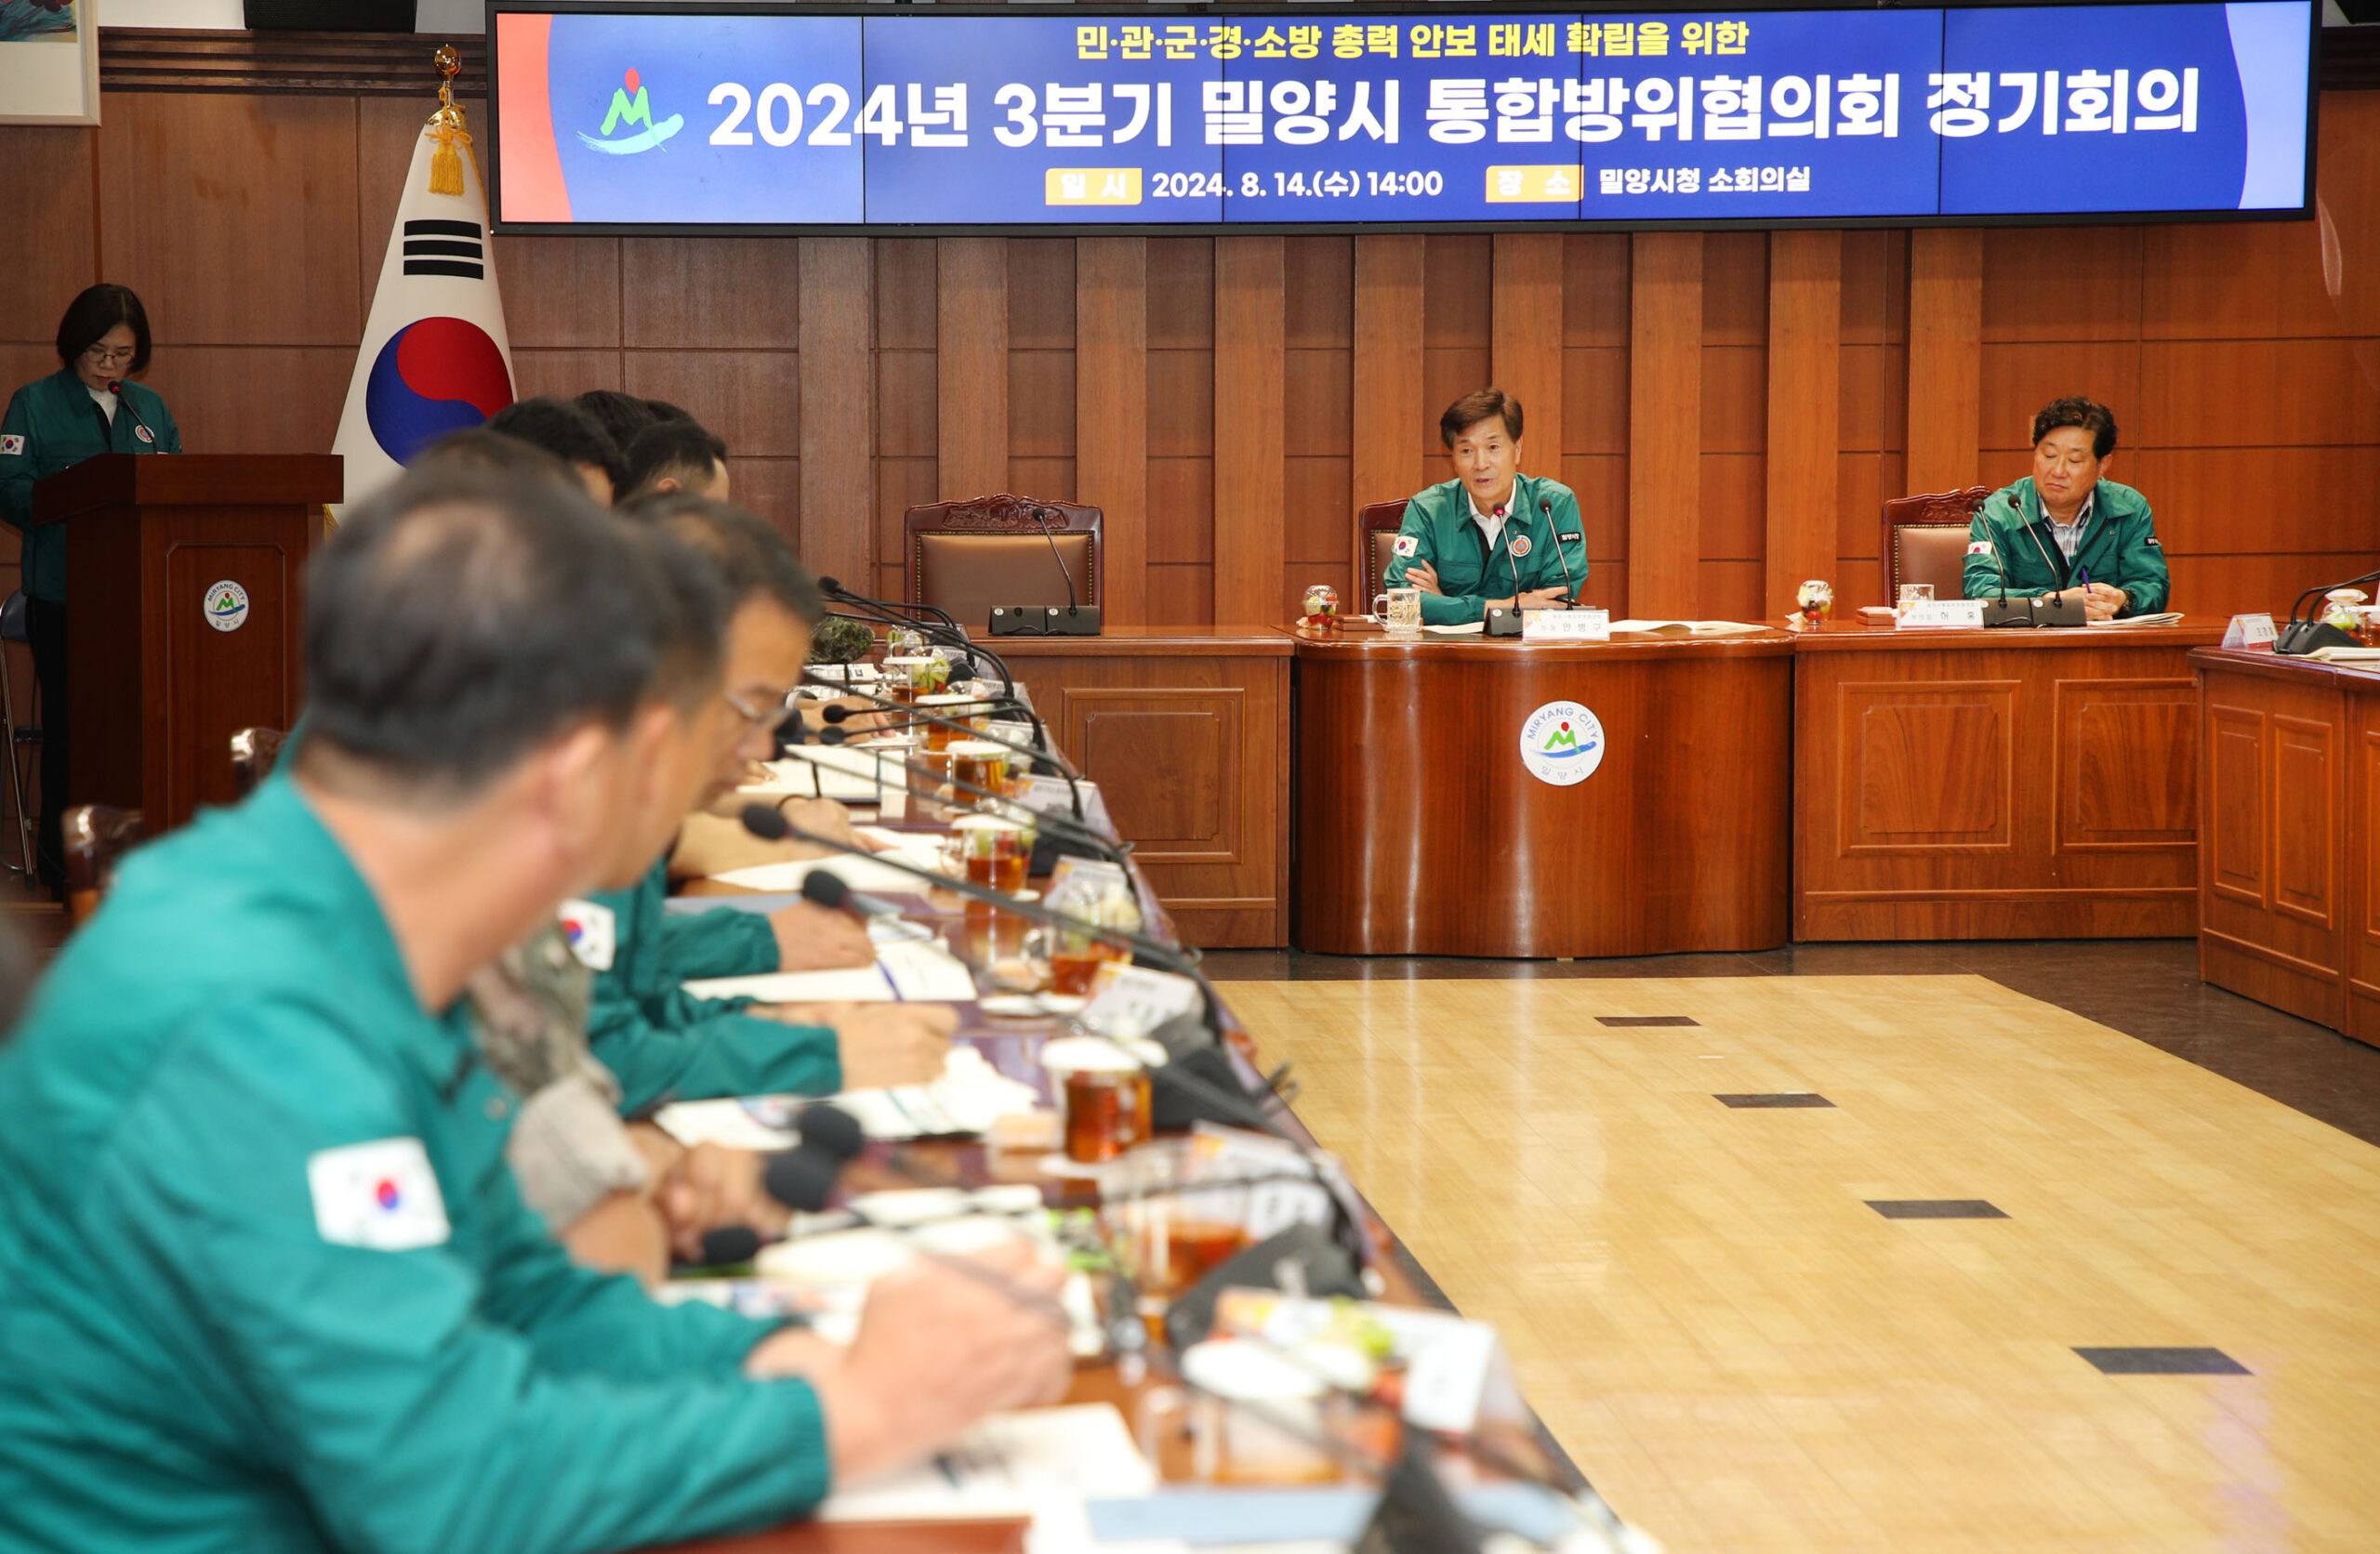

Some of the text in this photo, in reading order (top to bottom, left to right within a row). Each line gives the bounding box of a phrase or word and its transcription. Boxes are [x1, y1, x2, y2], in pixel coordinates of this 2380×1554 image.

[1332, 24, 1398, 59] 총력
[1409, 24, 1477, 58] 안보
[1488, 23, 1555, 57] 태세
[1567, 21, 1670, 57] 확립을
[1681, 20, 1750, 55] 위한
[707, 68, 2199, 148] 2024년 3분기 밀양시 통합방위협의회 정기회의
[1152, 172, 1234, 198] 2024.
[1240, 172, 1267, 197] 8.
[1367, 170, 1443, 196] 14:00
[1600, 166, 1810, 194] 밀양시청 소회의실
[207, 584, 245, 601] MIRYANG CITY
[1527, 707, 1598, 739] MIRYANG CITY
